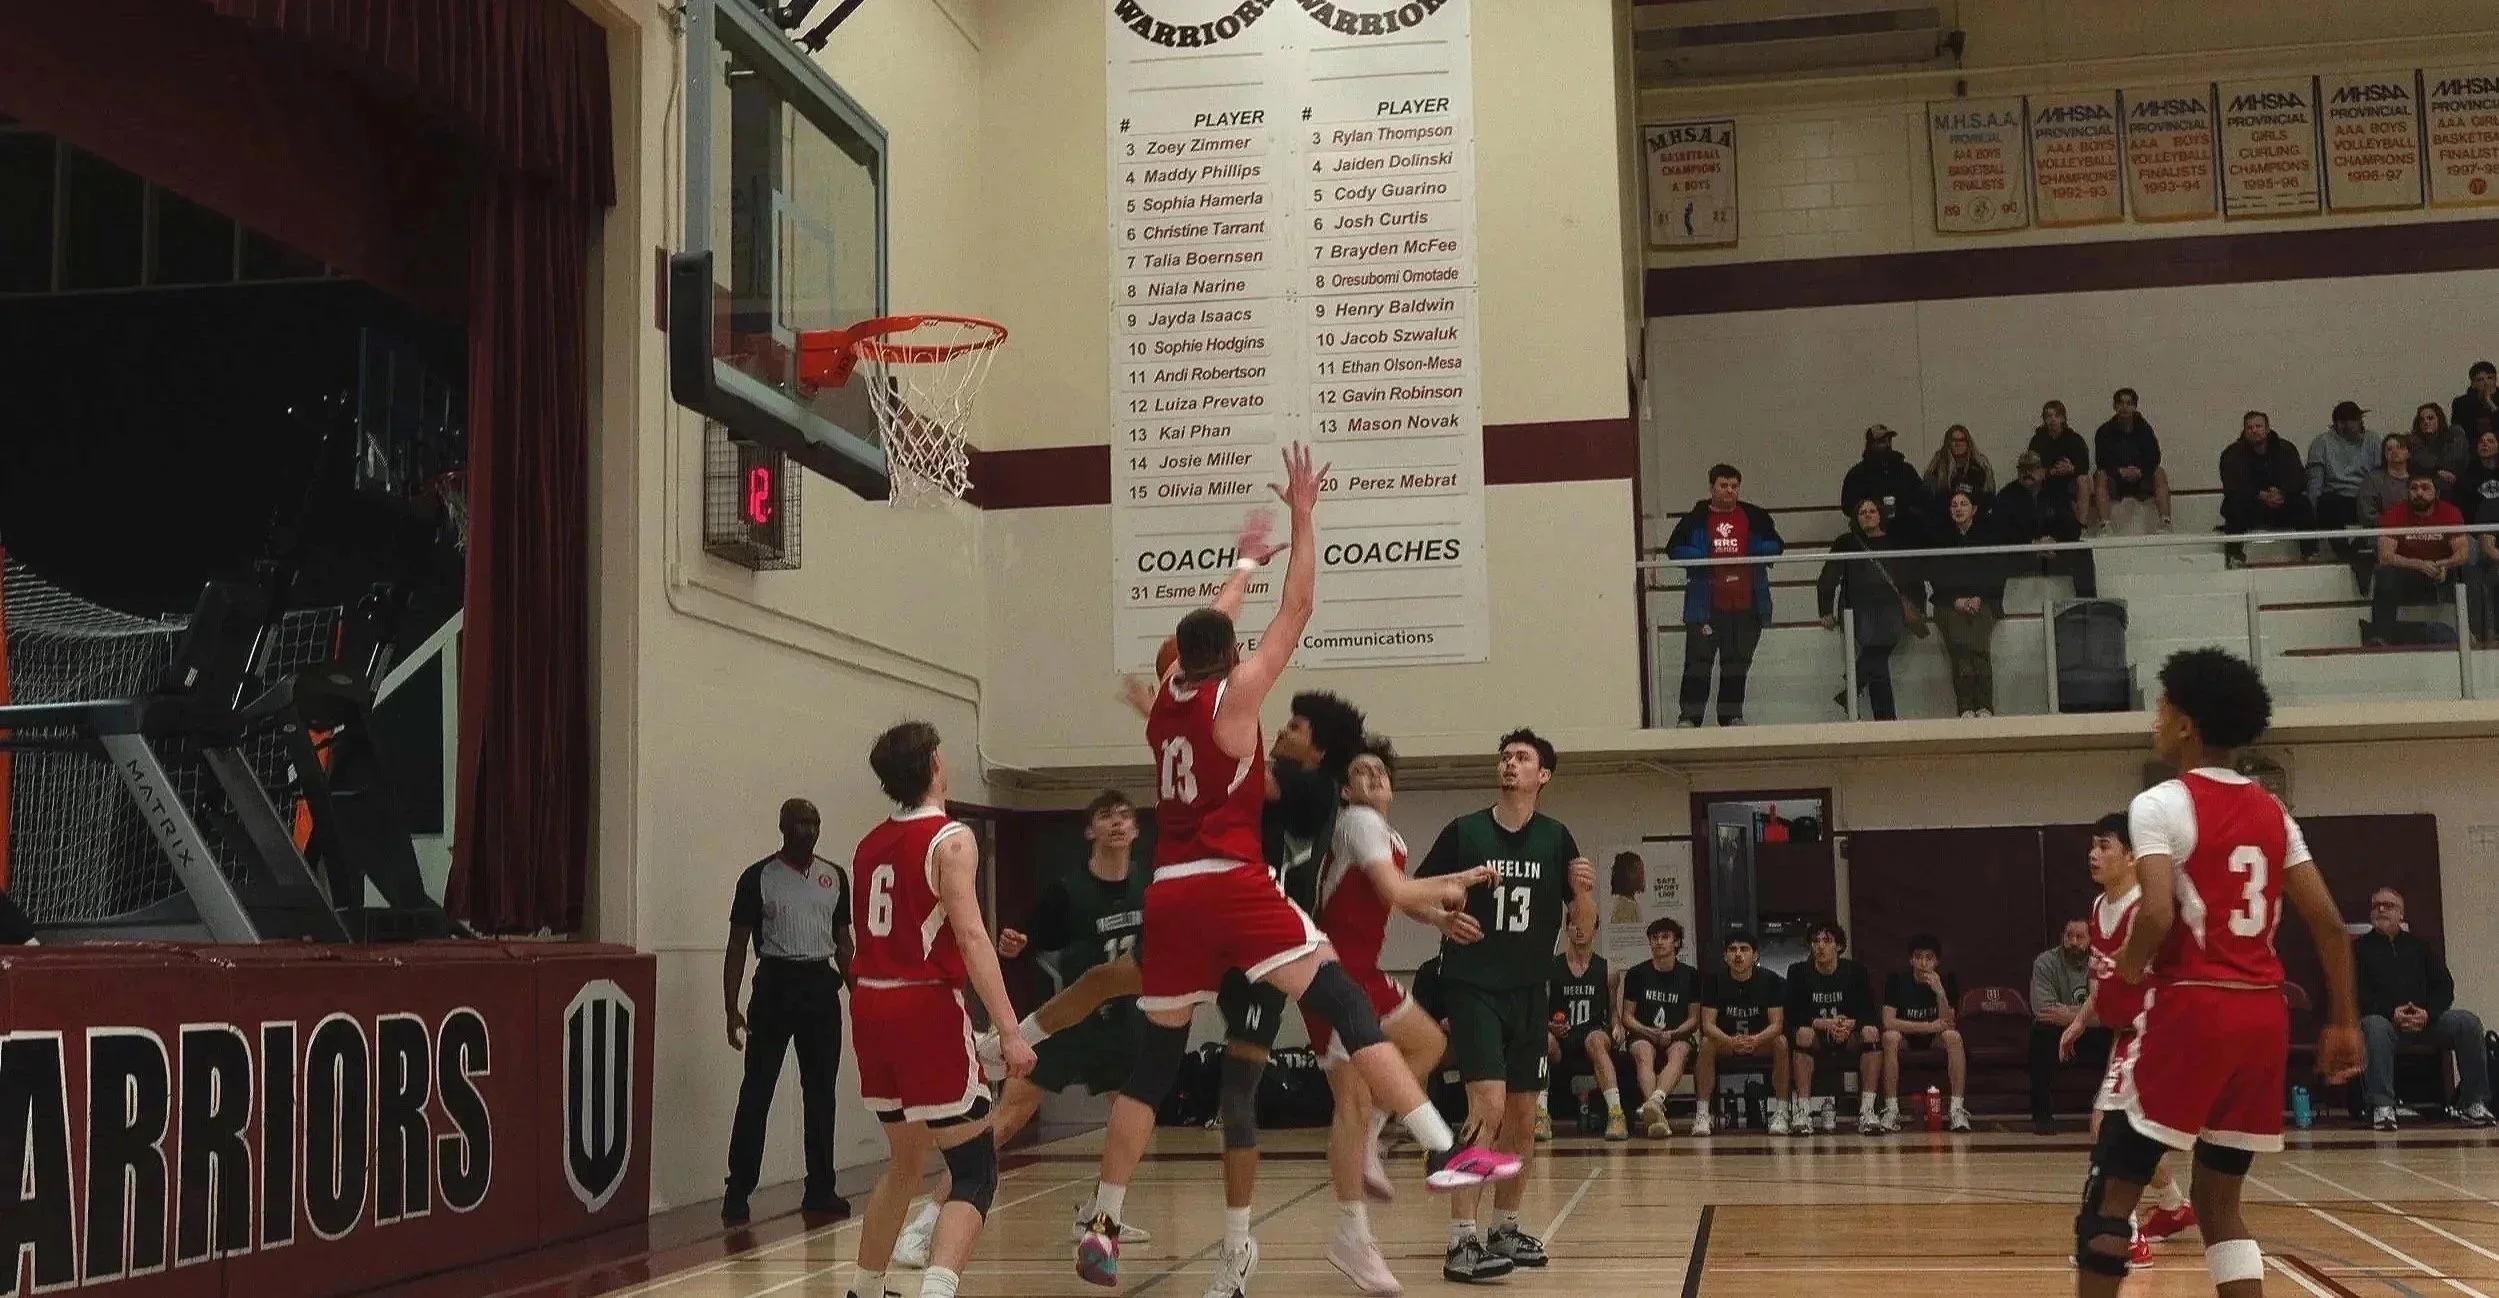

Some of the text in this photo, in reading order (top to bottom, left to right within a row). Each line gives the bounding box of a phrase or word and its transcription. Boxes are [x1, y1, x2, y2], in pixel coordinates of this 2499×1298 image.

[1114, 0, 1275, 47] WARRIOR
[2331, 84, 2409, 104] MHSAA
[2432, 77, 2499, 98] MHSA
[1302, 98, 1448, 121] # PLAYER
[2131, 98, 2208, 118] MHSAA
[2229, 92, 2305, 112] MHSAA
[1120, 110, 1264, 132] # PLAYER
[2037, 104, 2112, 124] MHSAA
[2228, 113, 2308, 127] PROVINCIAL
[2331, 105, 2412, 119] PROVINCIAL
[1312, 125, 1452, 145] 3 Rylan Thompson
[2036, 125, 2114, 139] PROVINCIAL
[2130, 120, 2207, 134] PROVINCIAL
[2252, 130, 2287, 142] GIRLS
[2336, 122, 2407, 135] AAA BOYS
[1126, 137, 1251, 156] 3 Zoey Zimmer
[1648, 127, 1731, 152] MHSAA
[2080, 140, 2115, 152] BOYS
[2130, 133, 2209, 150] AAA BOYS
[2334, 138, 2415, 150] VOLLEYBALL
[2131, 151, 2210, 164] VOLLEYBALL
[2239, 145, 2300, 159] CURLING
[2334, 153, 2415, 167] CHAMPIONS
[1313, 152, 1452, 173] 4 Jaiden Dolinski
[2038, 155, 2116, 169] VOLLEYBALL
[2230, 159, 2309, 175] CHAMPIONS
[1125, 164, 1260, 186] 4 Maddy Phillips
[2040, 170, 2116, 185] CHAMPIONS
[2139, 165, 2207, 179] FINALISTS
[1314, 182, 1447, 202] 5 Cody Guarino
[1127, 192, 1263, 213] 5 Sophia Hamerla
[1314, 211, 1428, 230] 6 Josh Curtis
[1127, 220, 1264, 241] 6 Christine Tarrant
[1128, 250, 1263, 269] 7 Talia Boernsen
[1314, 240, 1457, 260] 7 Brayden McFee
[1316, 268, 1458, 288] 8 Oresubomi Omotade
[1128, 279, 1245, 298] 8 Niala Narine
[1316, 298, 1455, 318] 9 Henry Baldwin
[1128, 308, 1251, 328] 9 Jayda Isaacs
[1316, 327, 1457, 346] 10 Jacob Szwaluk
[1128, 336, 1264, 357] 10 Sophie Hodgins
[1128, 365, 1266, 384] 11 Andi Robertson
[1318, 356, 1462, 375] 11 Ethan Olson-Mesa
[1129, 394, 1264, 413] 12 Luiza Prevato
[1318, 385, 1462, 404] 12 Gavin Robinson
[1319, 413, 1459, 433] 13 Mason Novak
[1129, 424, 1230, 442] 13 Kai Phan
[1129, 452, 1252, 470] 14 Josie Miller
[1129, 481, 1253, 499] 15 Olivia Miller
[1320, 473, 1456, 491] 20 Perez Mebrat
[1138, 546, 1270, 572] COACH
[1324, 539, 1461, 565] COACHES
[1132, 587, 1148, 600] 31
[1155, 584, 1196, 599] Esme
[1304, 631, 1434, 649] Communications
[1161, 735, 1198, 805] 13
[127, 760, 193, 868] MATRIX
[867, 863, 895, 937] 6
[2228, 845, 2268, 937] 3
[1493, 886, 1531, 932] 13
[1564, 985, 1594, 996] NEELIN
[1646, 989, 1678, 1003] NEELIN
[1245, 1002, 1262, 1032] N
[1569, 1000, 1591, 1026] 10
[1653, 1006, 1666, 1029] 4
